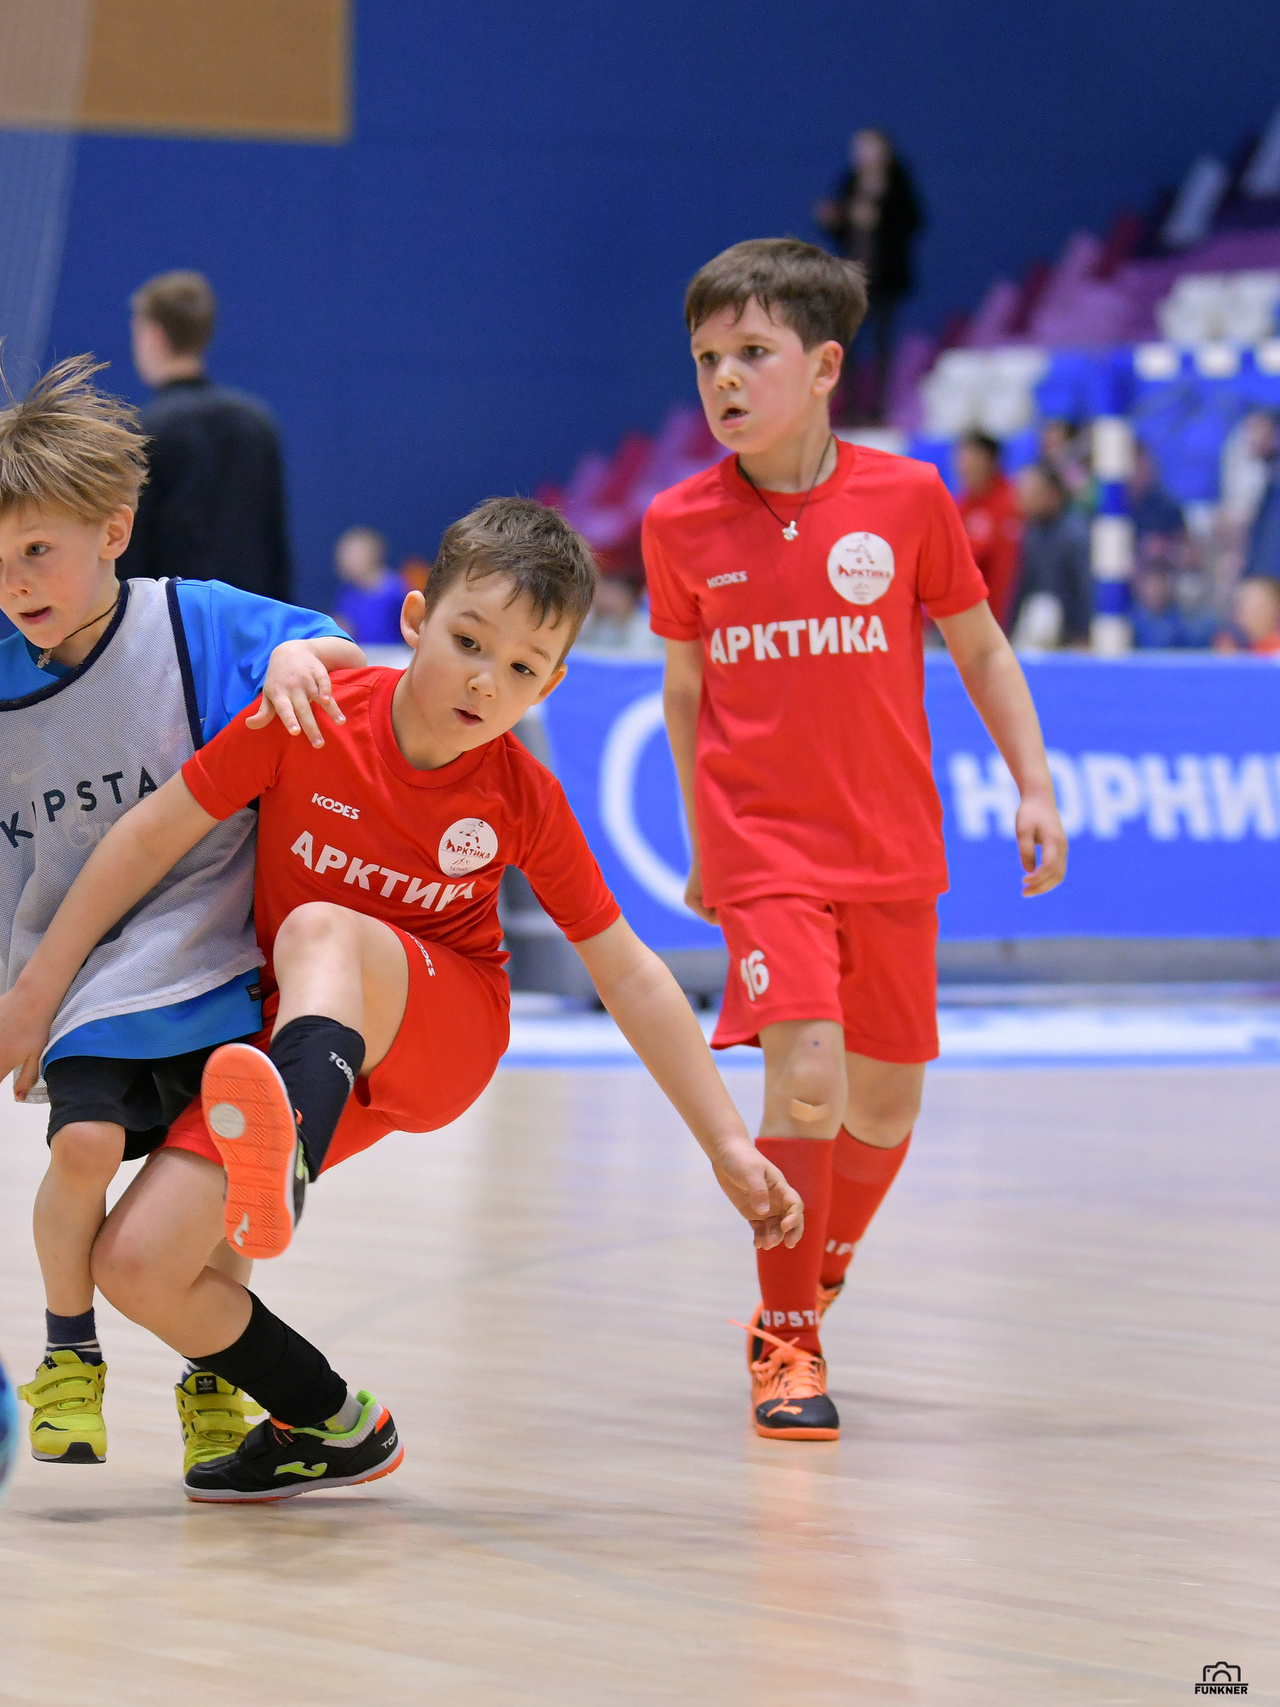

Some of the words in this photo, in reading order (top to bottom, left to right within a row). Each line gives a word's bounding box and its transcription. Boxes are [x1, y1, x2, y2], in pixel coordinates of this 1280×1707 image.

[710, 615, 889, 664] АРКТИКА
[311, 793, 361, 820] KODES
[949, 748, 1280, 842] НРНИ
[741, 949, 770, 1002] 16
